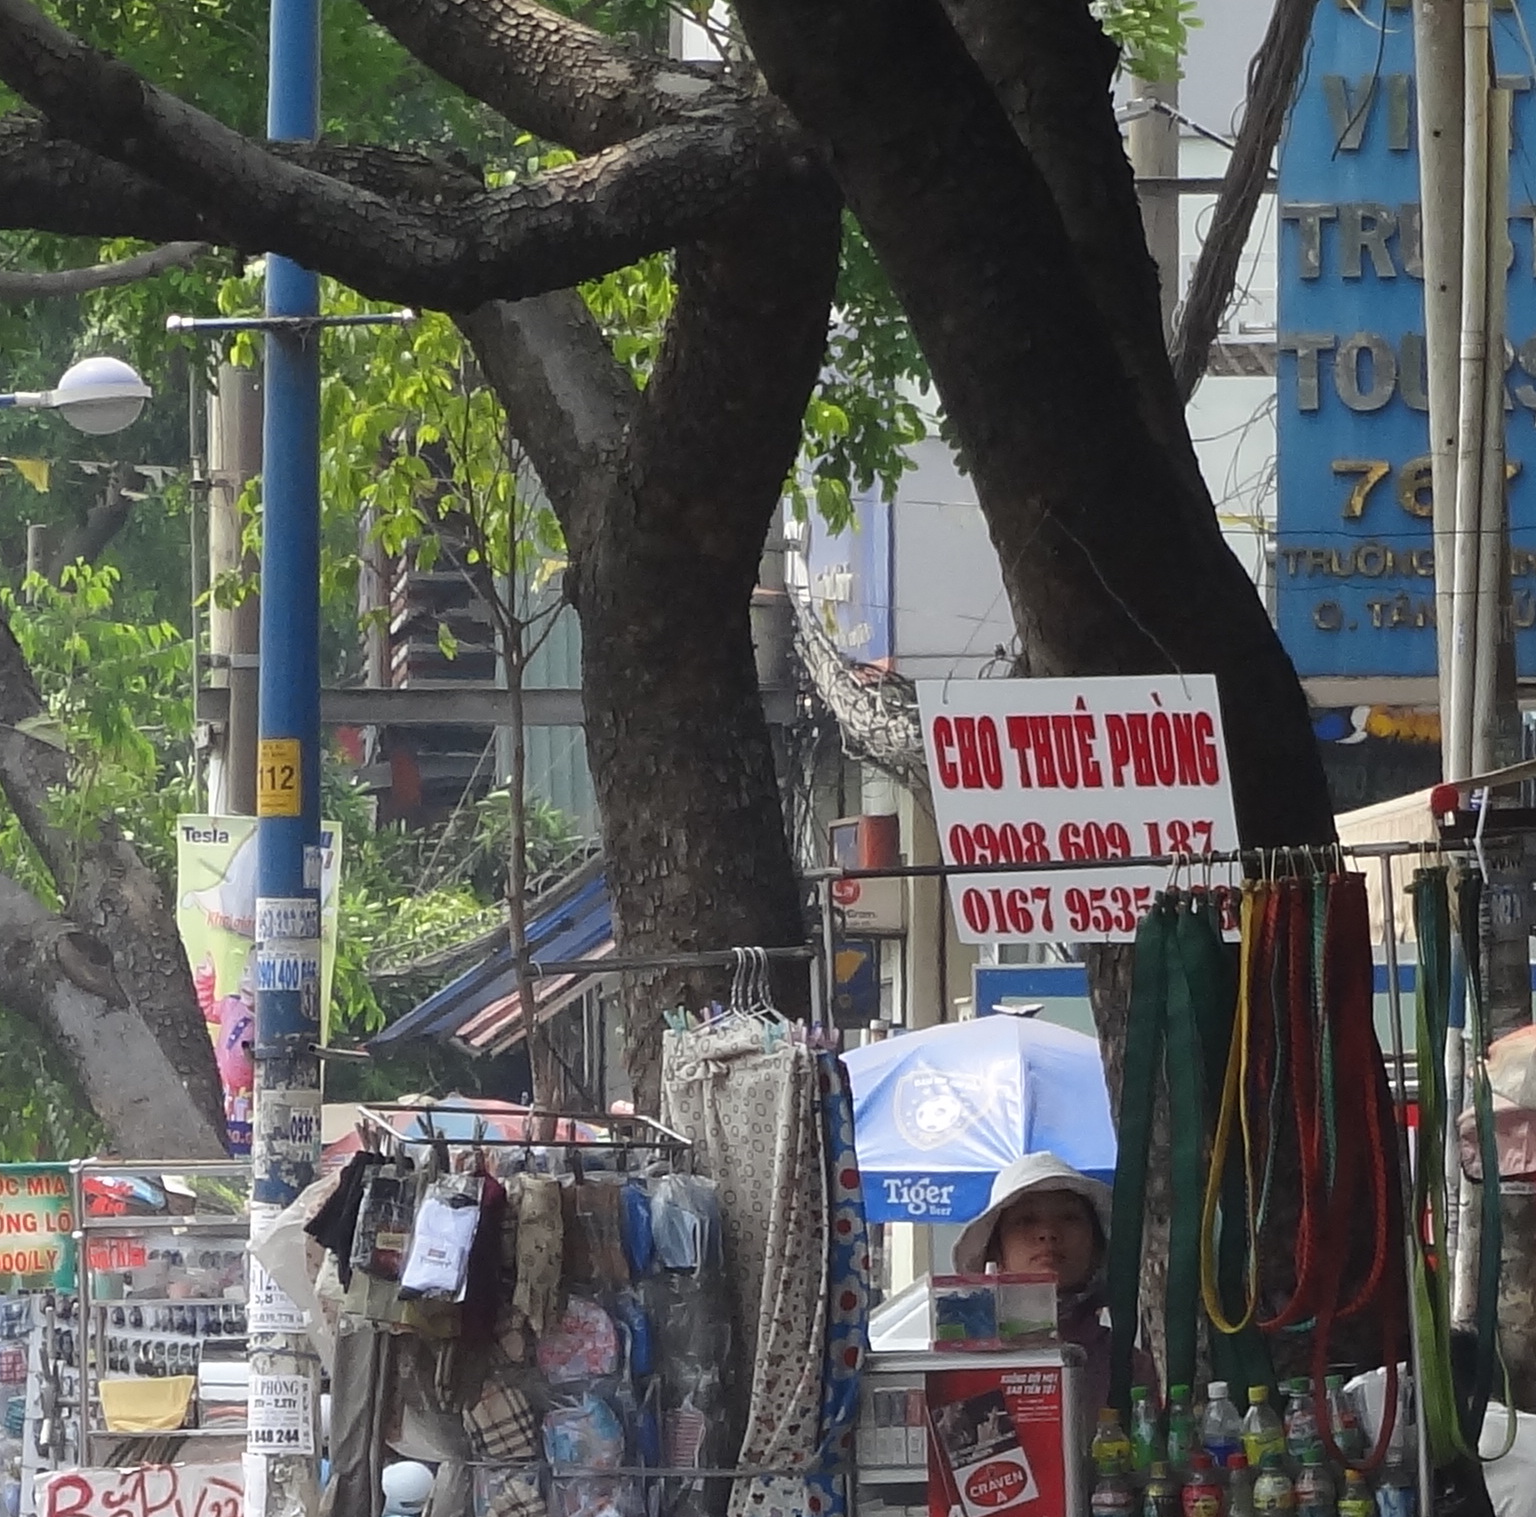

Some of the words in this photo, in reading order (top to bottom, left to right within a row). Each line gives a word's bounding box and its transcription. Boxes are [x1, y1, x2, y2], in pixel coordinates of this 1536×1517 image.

[1323, 73, 1532, 150] VIT
[932, 715, 1004, 790] CHO
[1005, 695, 1103, 789] THUÊ
[1104, 692, 1220, 787] PHÒNG
[182, 827, 230, 844] Tesla
[949, 821, 1050, 866] 0908
[1058, 820, 1131, 862] 609
[1143, 820, 1214, 855] 187
[962, 886, 1055, 934] 0167
[882, 1177, 956, 1216] Tiger
[969, 1470, 1024, 1498] CRAVEN
[996, 1491, 1008, 1503] A
